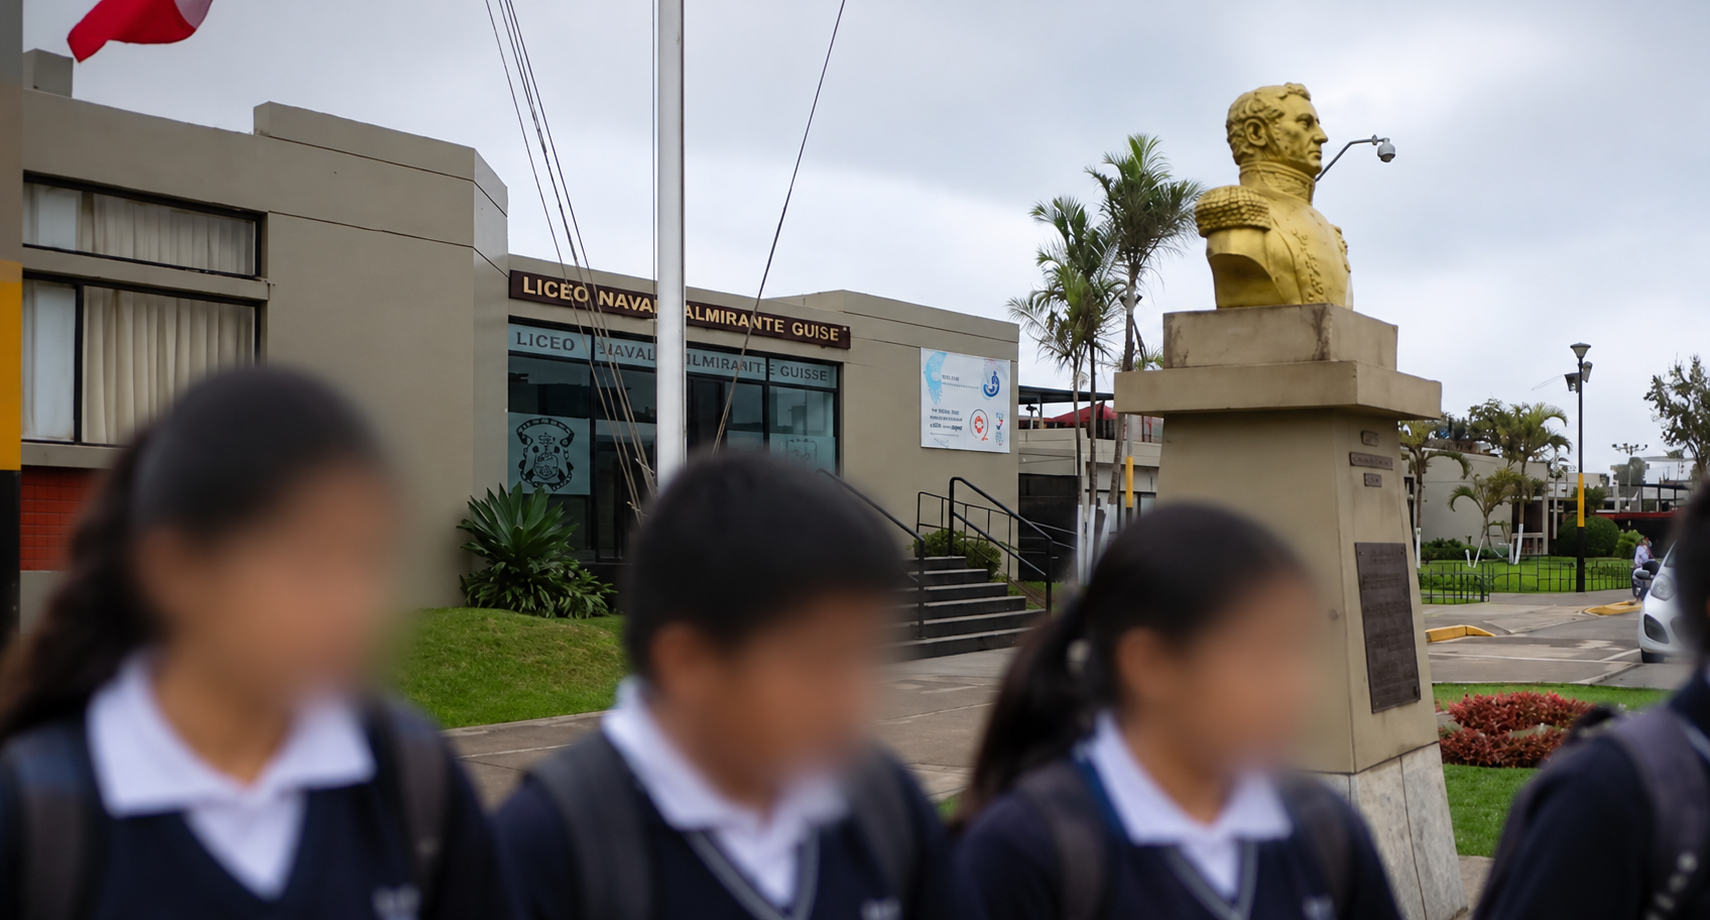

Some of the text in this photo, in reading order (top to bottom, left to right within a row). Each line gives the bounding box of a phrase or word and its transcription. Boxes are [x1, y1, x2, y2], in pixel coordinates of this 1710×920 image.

[523, 276, 589, 303] LICEO
[686, 305, 784, 334] ALMIRANTE
[792, 322, 839, 342] GUISE
[516, 331, 575, 351] LICEO
[780, 365, 827, 381] GUISSE
